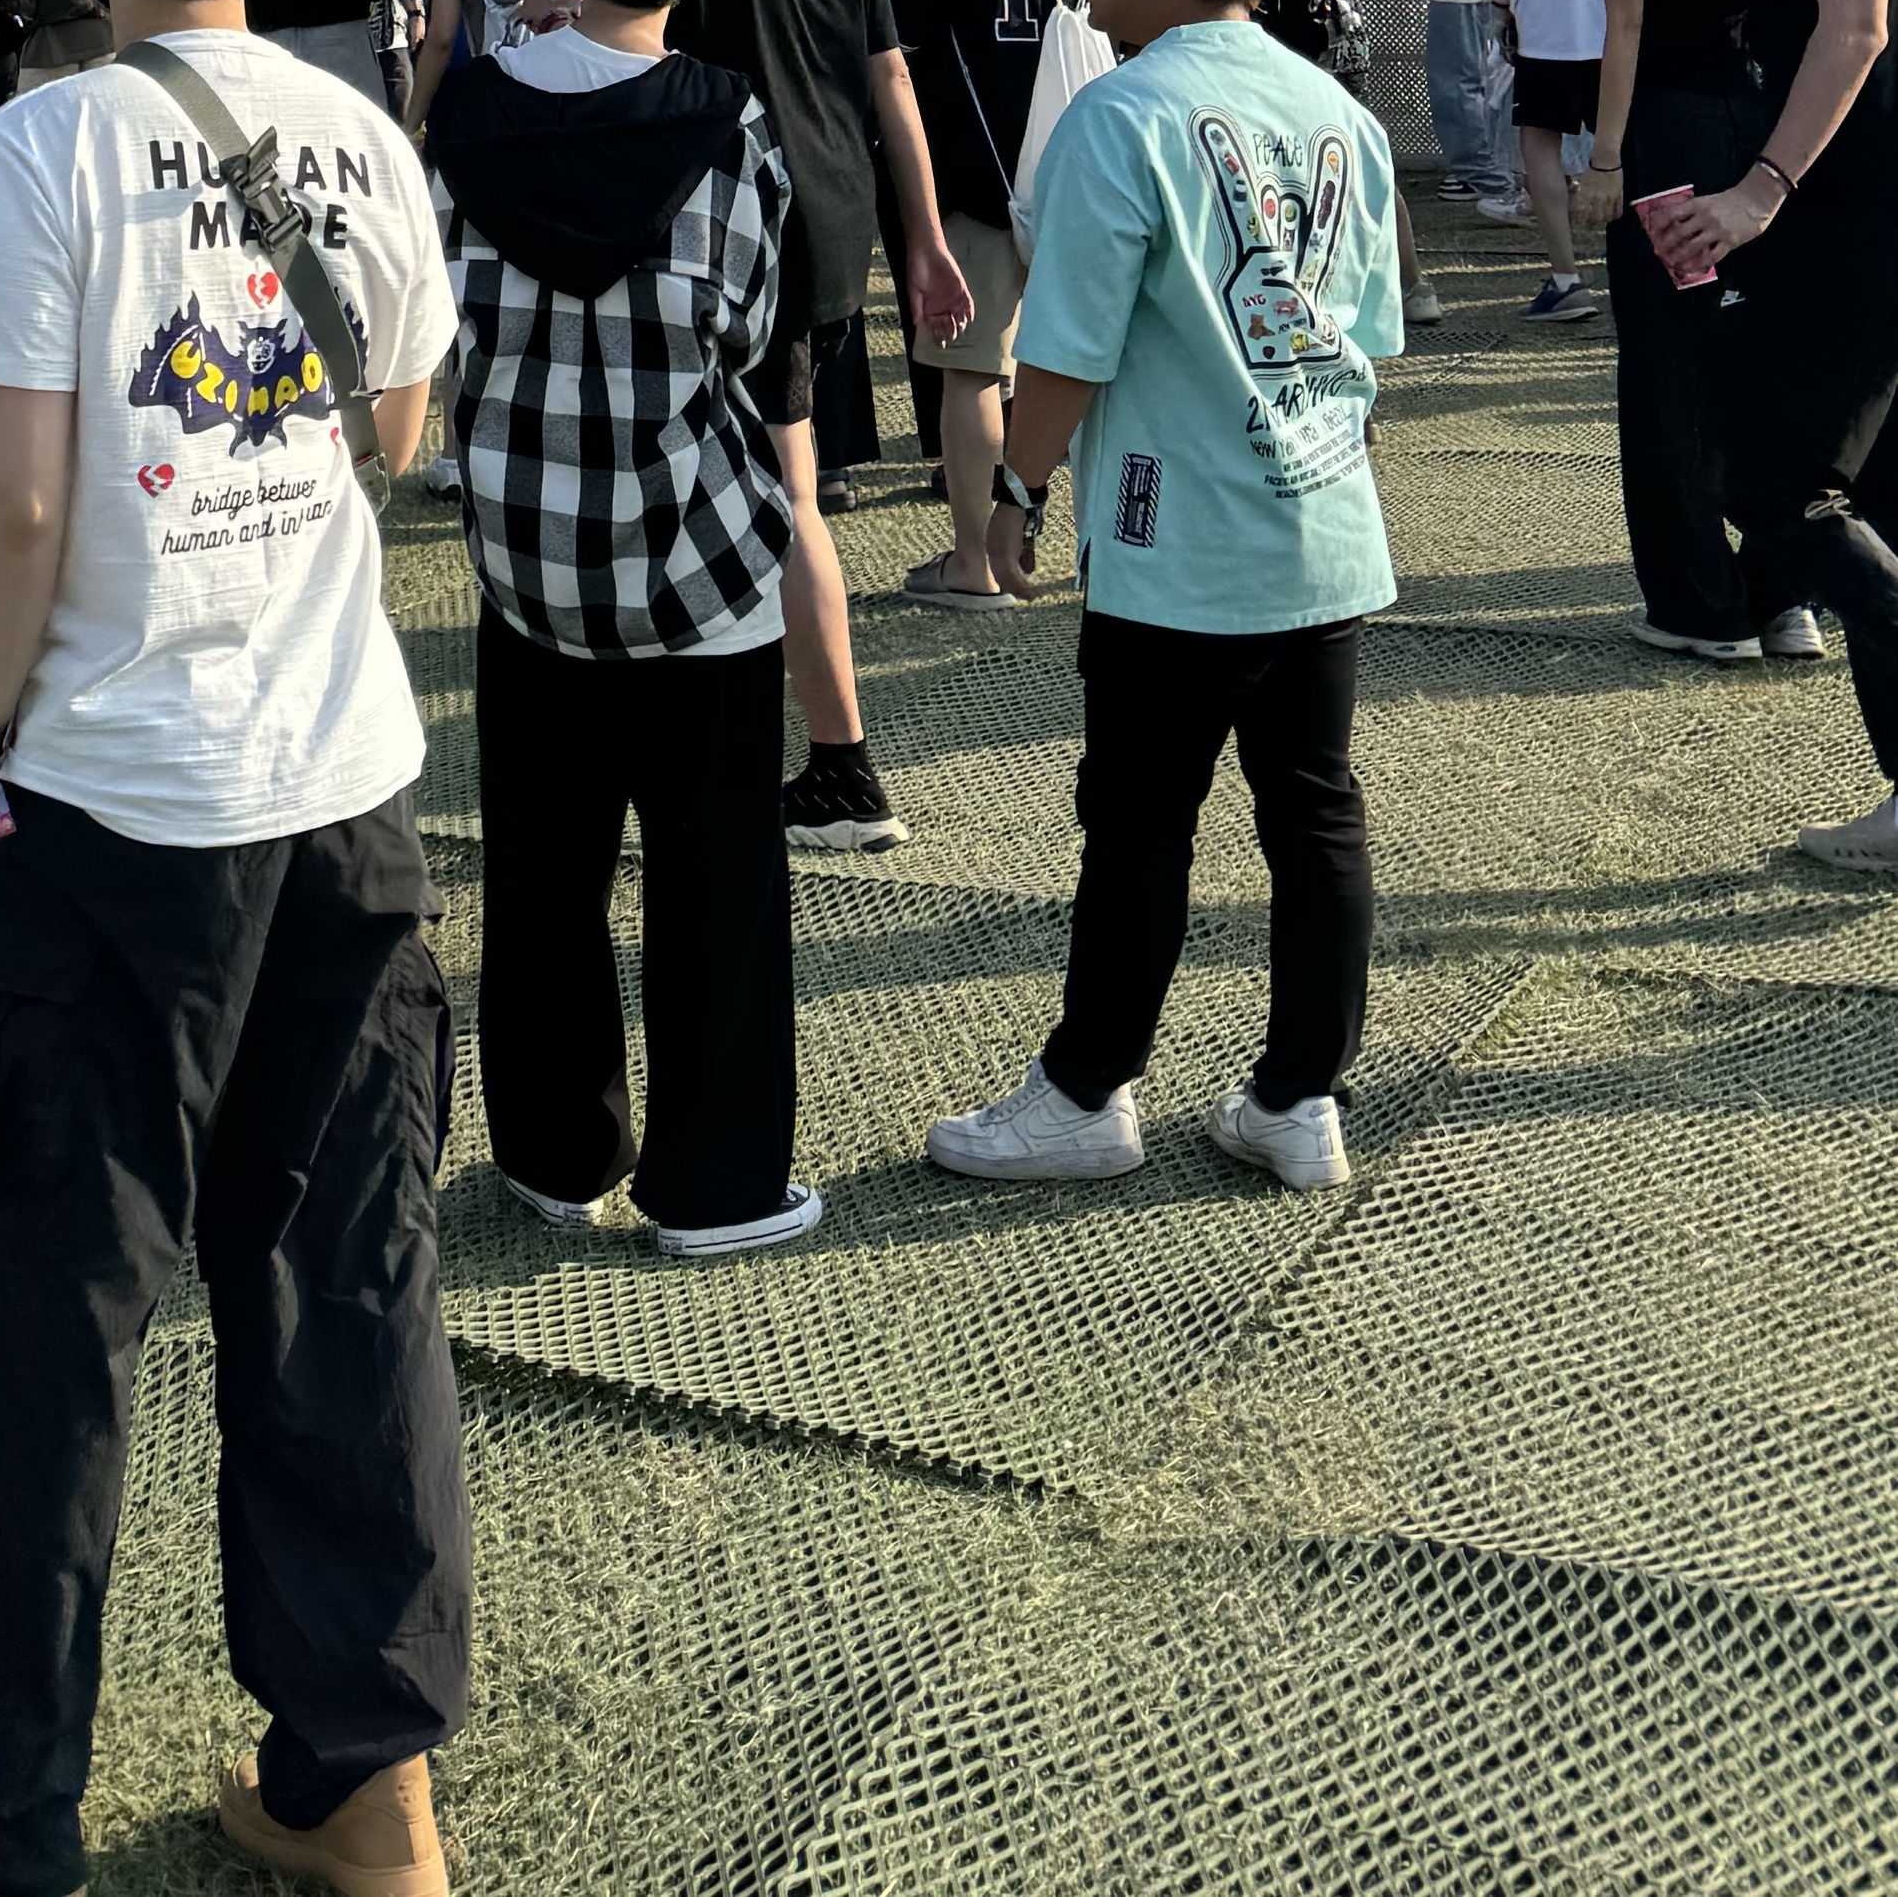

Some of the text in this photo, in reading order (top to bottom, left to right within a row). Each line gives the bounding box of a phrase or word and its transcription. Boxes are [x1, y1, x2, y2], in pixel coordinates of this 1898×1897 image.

[149, 140, 371, 197] HUAN
[190, 202, 348, 250] MAE
[191, 485, 254, 521] bridge
[161, 527, 234, 556] human
[239, 512, 276, 543] and
